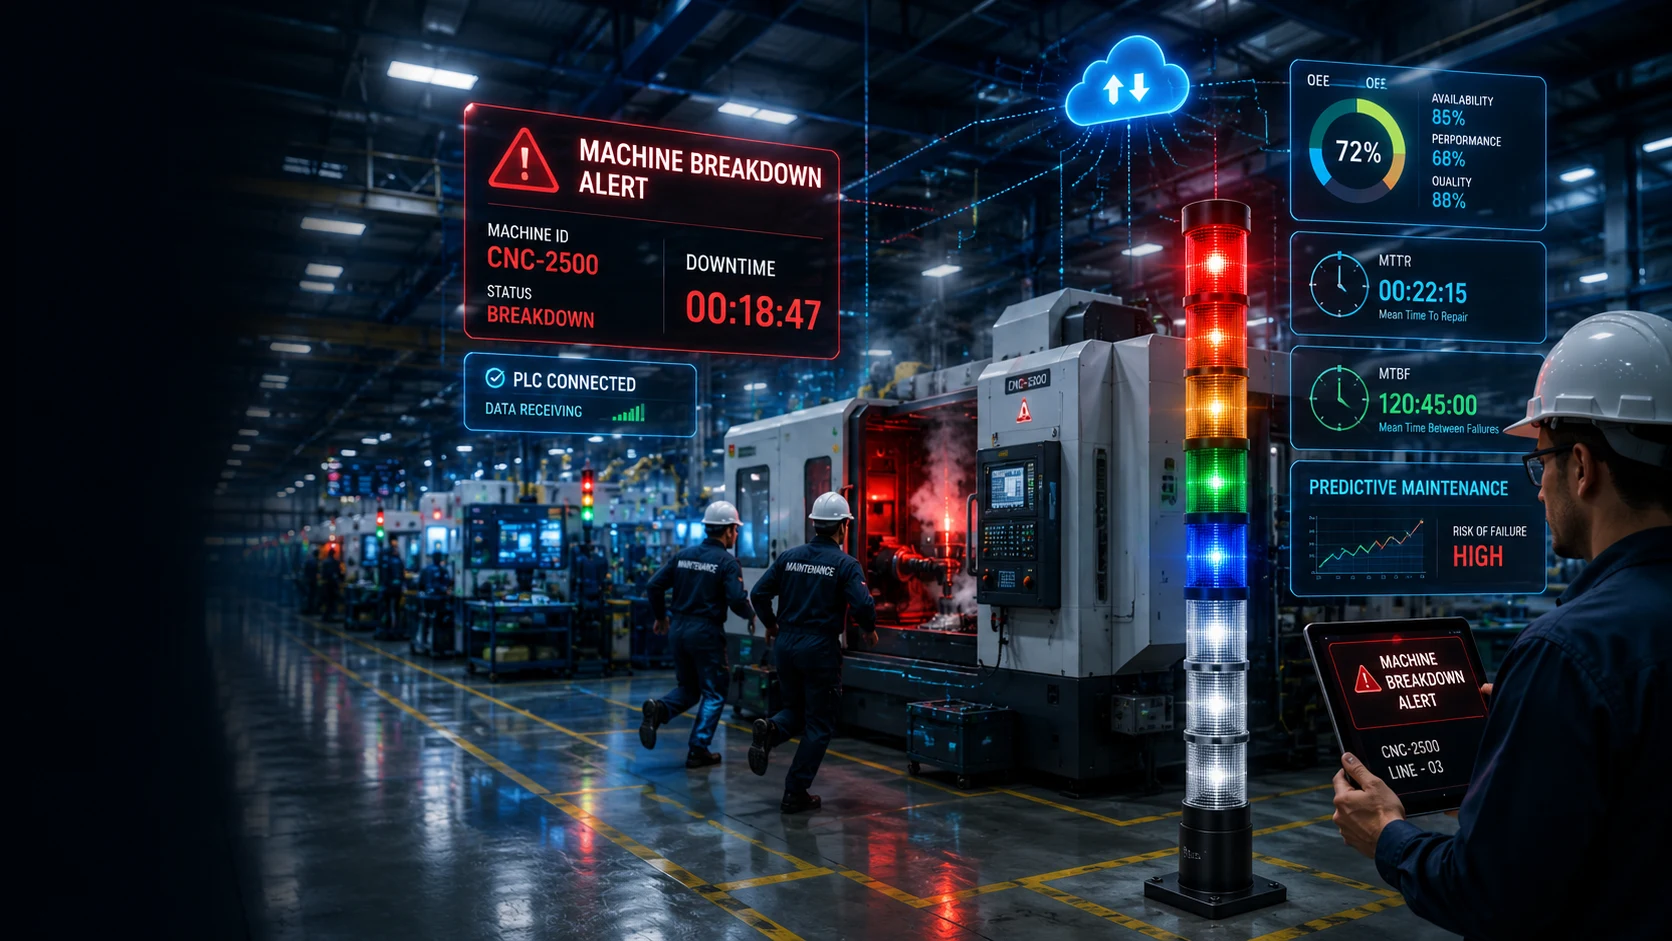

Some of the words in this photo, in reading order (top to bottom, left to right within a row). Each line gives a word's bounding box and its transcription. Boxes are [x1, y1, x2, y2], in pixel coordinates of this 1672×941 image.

[1307, 74, 1330, 86] OEE
[1432, 93, 1494, 106] AVAILABILITY
[1432, 109, 1466, 126] 85%
[1336, 140, 1381, 163] 72%
[1432, 150, 1466, 168] 68%
[580, 138, 683, 173] MACHINE
[690, 152, 822, 189] BREAKDOWN
[579, 170, 648, 200] ALERT
[1432, 192, 1466, 209] 88%
[487, 223, 552, 242] MACHINE
[555, 229, 569, 243] ID
[487, 246, 599, 276] CNC-2500
[686, 254, 776, 277] DOWNTIME
[1379, 254, 1411, 267] MTTR
[487, 285, 532, 300] STATUS
[1379, 279, 1467, 304] 00:22:15
[487, 306, 595, 329] BREAKDOWN
[685, 290, 822, 331] 00:18:47
[1379, 309, 1403, 320] Mean
[1405, 310, 1426, 321] Time
[1428, 311, 1439, 321] To
[1441, 311, 1468, 323] Repair
[513, 372, 542, 388] PLC
[546, 373, 636, 392] CONNECTED
[1379, 367, 1411, 380] MTBF
[485, 402, 516, 416] DATA
[520, 404, 582, 417] RECEIVING
[1379, 392, 1477, 416] 120:45:00
[1379, 422, 1403, 432] Mean
[1405, 422, 1426, 433] Time
[1428, 423, 1464, 433] Between
[1309, 479, 1397, 495] PREDICTIVE
[1402, 480, 1508, 496] MAINTENANCE
[1453, 525, 1474, 536] RISK
[1476, 526, 1488, 536] OF
[1490, 526, 1527, 536] FAILURE
[1453, 545, 1503, 567] HIGH
[1379, 652, 1438, 669] MACHINE
[1385, 670, 1465, 690] BREAKDOWN
[1399, 693, 1437, 710] ALERT
[1381, 739, 1440, 758] CNC-2500
[1388, 762, 1418, 780] LINE
[1429, 760, 1443, 774] 03
